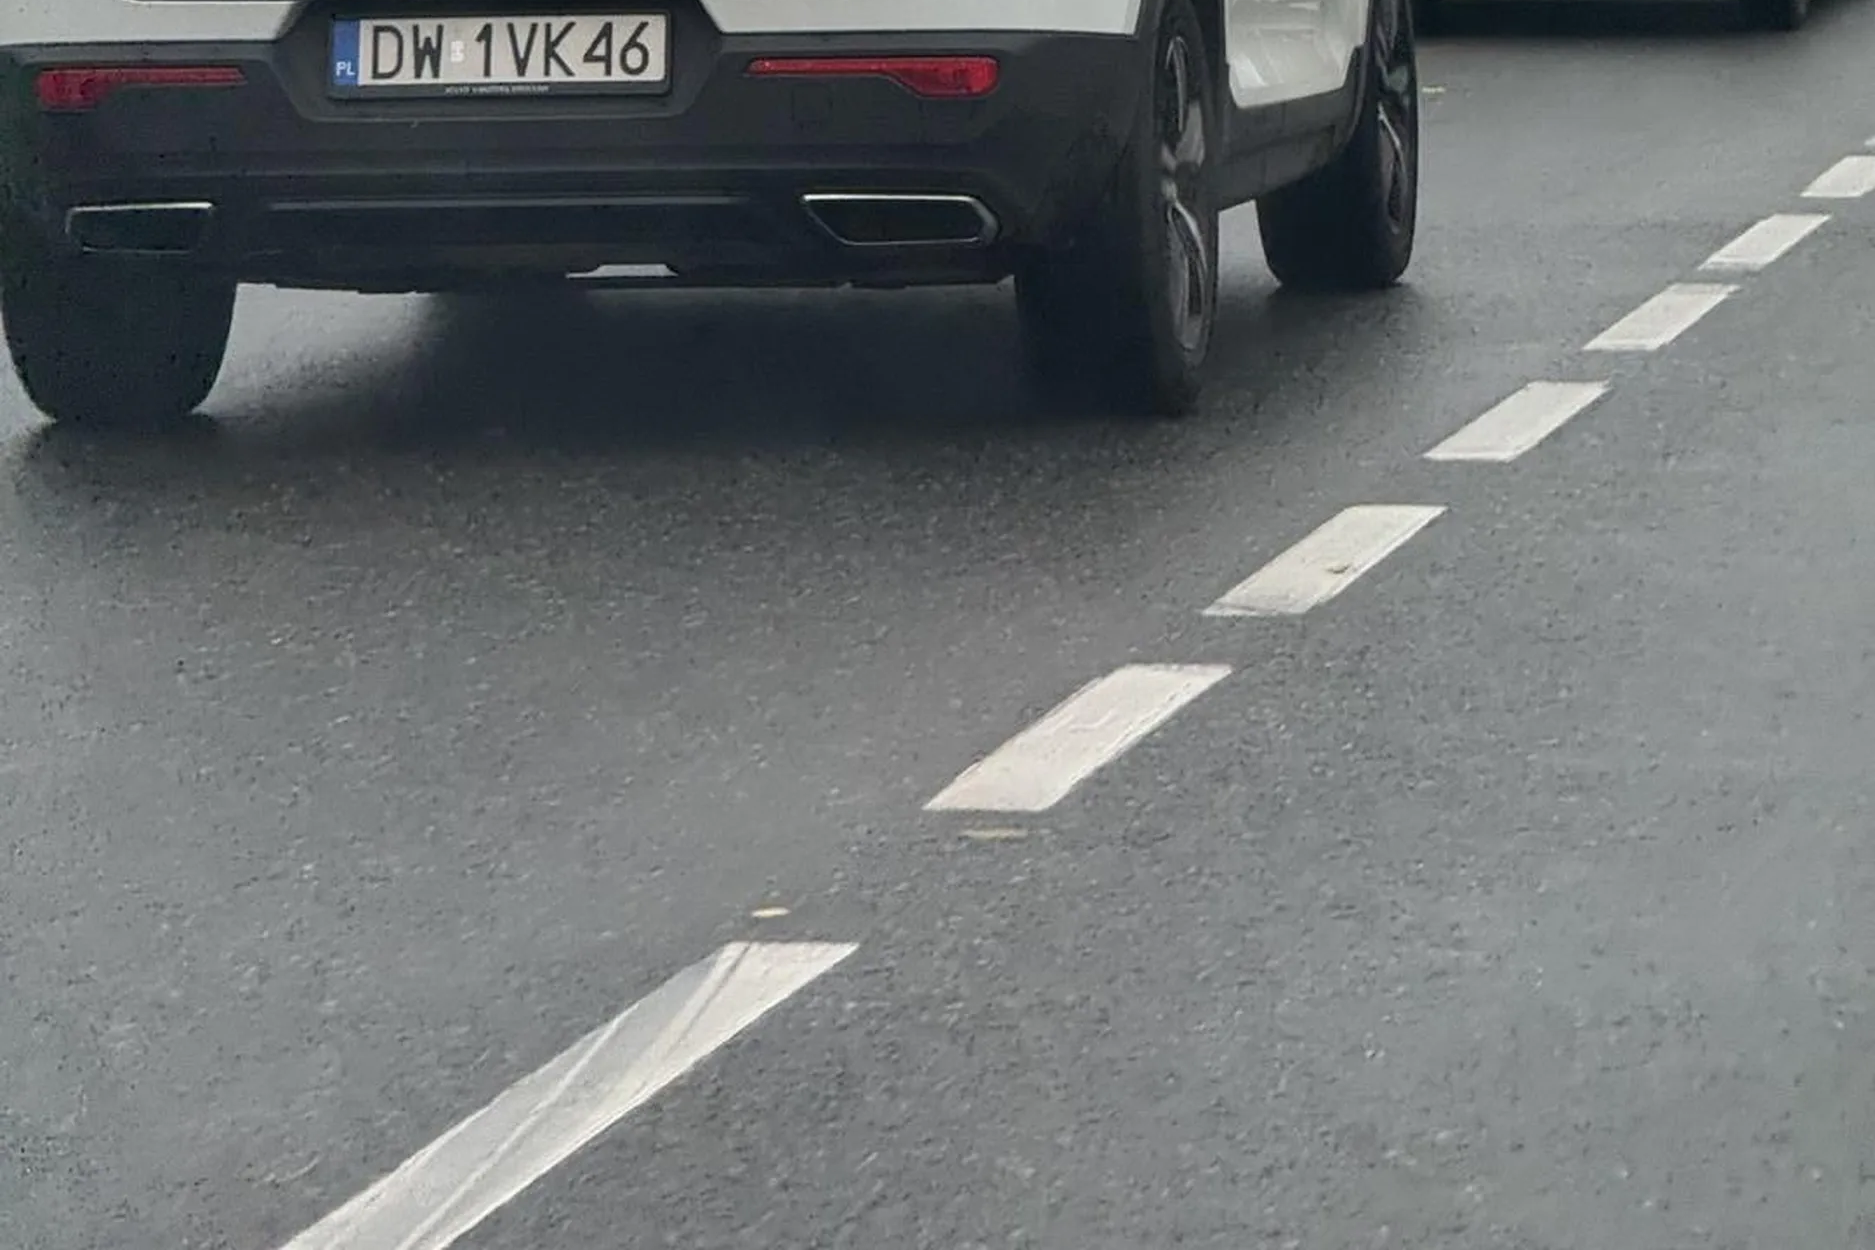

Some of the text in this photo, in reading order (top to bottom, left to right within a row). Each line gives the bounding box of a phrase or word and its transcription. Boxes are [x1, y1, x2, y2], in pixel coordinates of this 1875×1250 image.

[371, 21, 650, 79] DW 1VK46
[336, 61, 356, 76] PL
